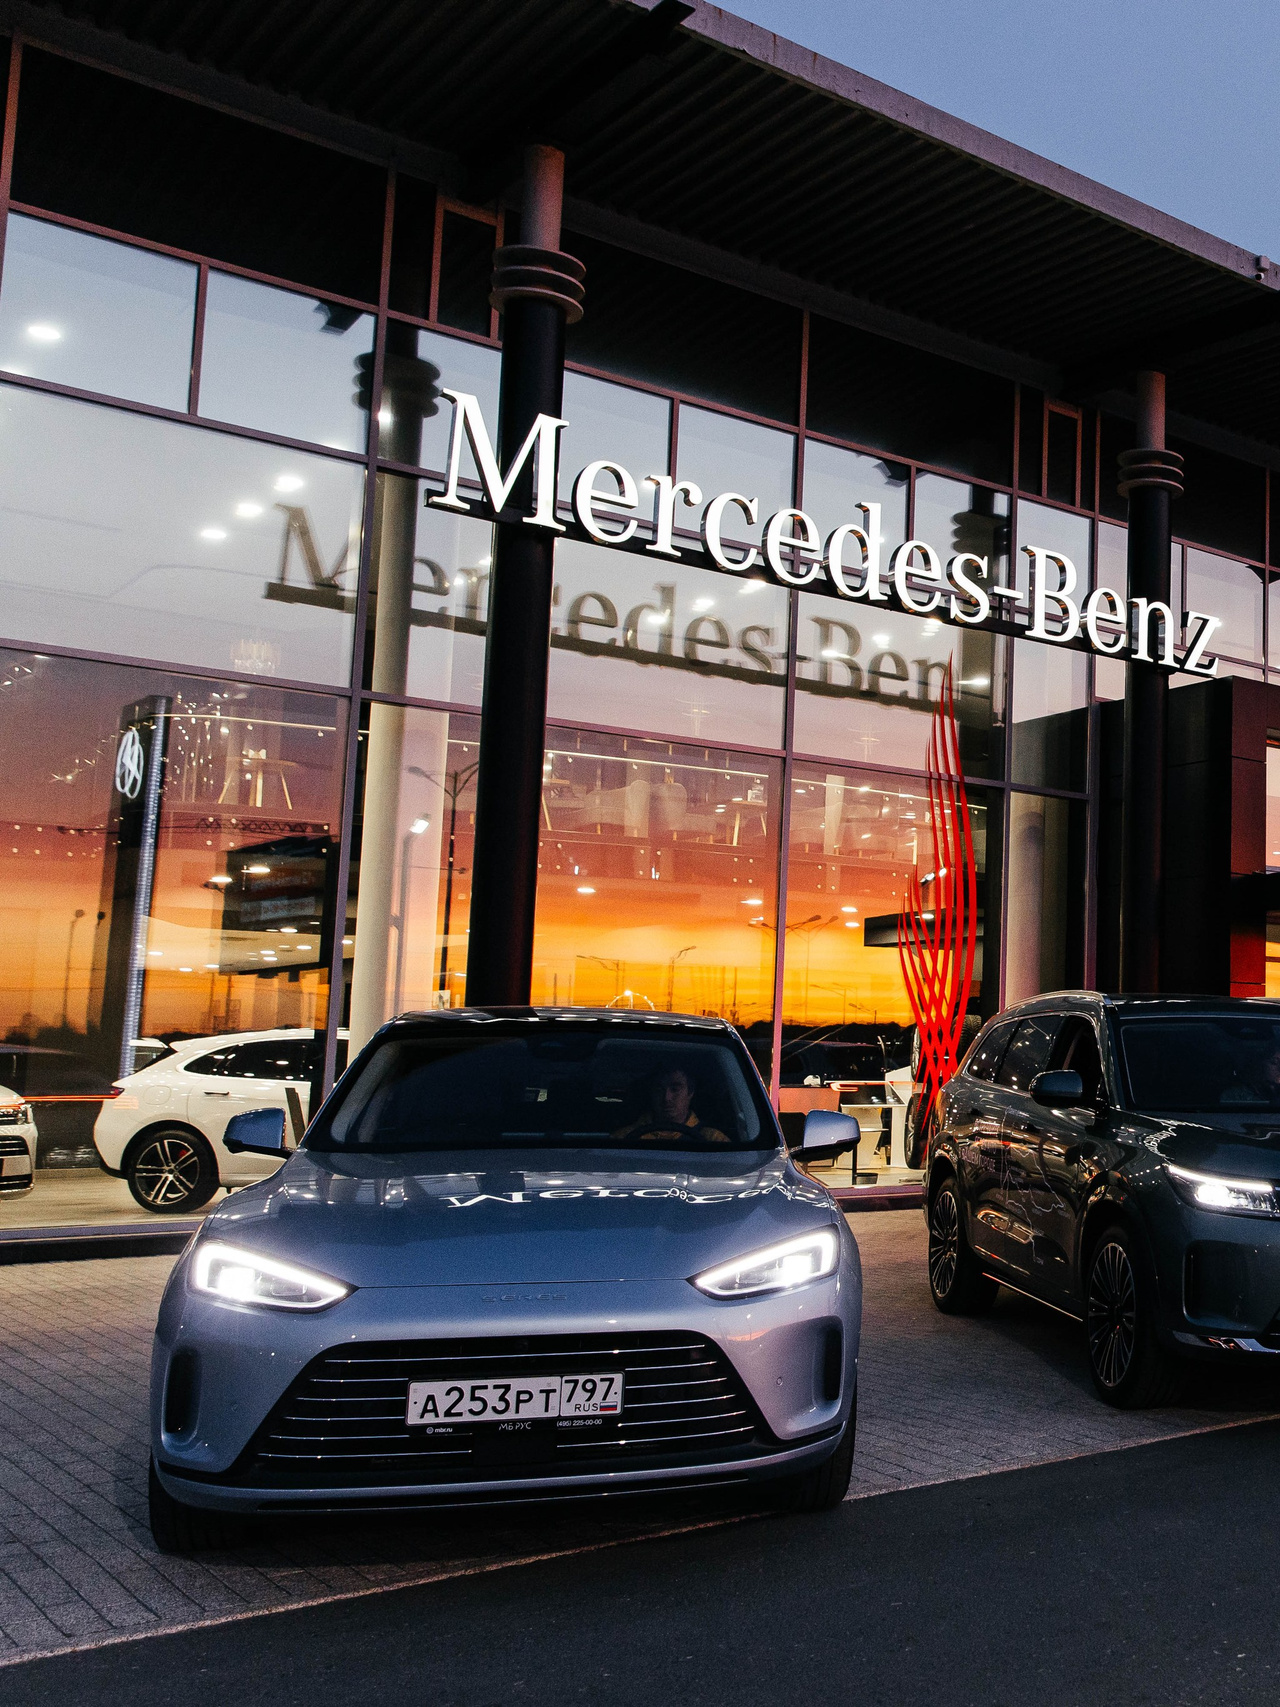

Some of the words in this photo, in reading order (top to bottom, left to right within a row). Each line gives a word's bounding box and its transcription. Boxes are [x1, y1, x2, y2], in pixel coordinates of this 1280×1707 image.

[427, 388, 1222, 676] Mercedes-Benz
[419, 1384, 557, 1419] А253РТ
[564, 1378, 615, 1404] 797
[574, 1403, 599, 1413] RUS
[572, 1418, 602, 1426] 225-00-00
